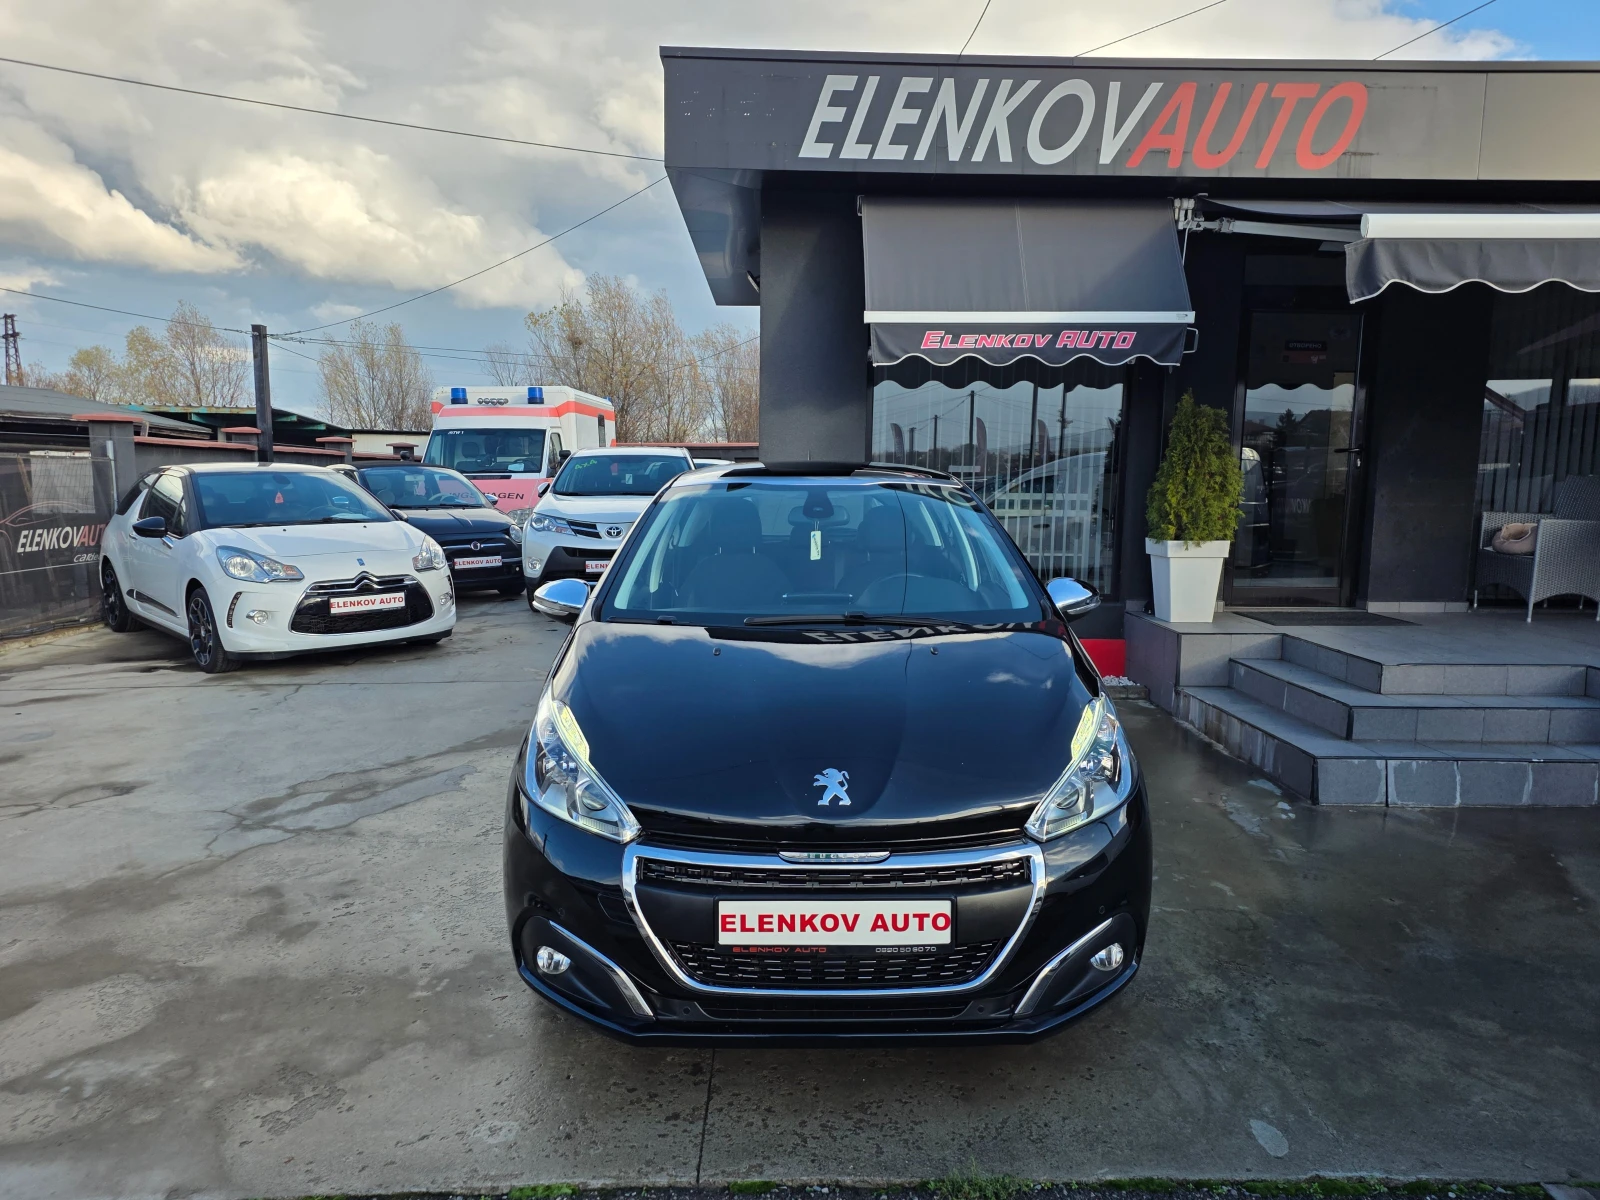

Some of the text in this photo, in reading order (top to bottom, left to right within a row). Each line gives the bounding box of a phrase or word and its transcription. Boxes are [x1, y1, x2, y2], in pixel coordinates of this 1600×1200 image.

[920, 330, 1137, 349] ELENKOV AUTO
[329, 599, 377, 609] ELENKOV
[379, 596, 404, 605] AUTO
[720, 912, 952, 933] ELENKOV AUTO
